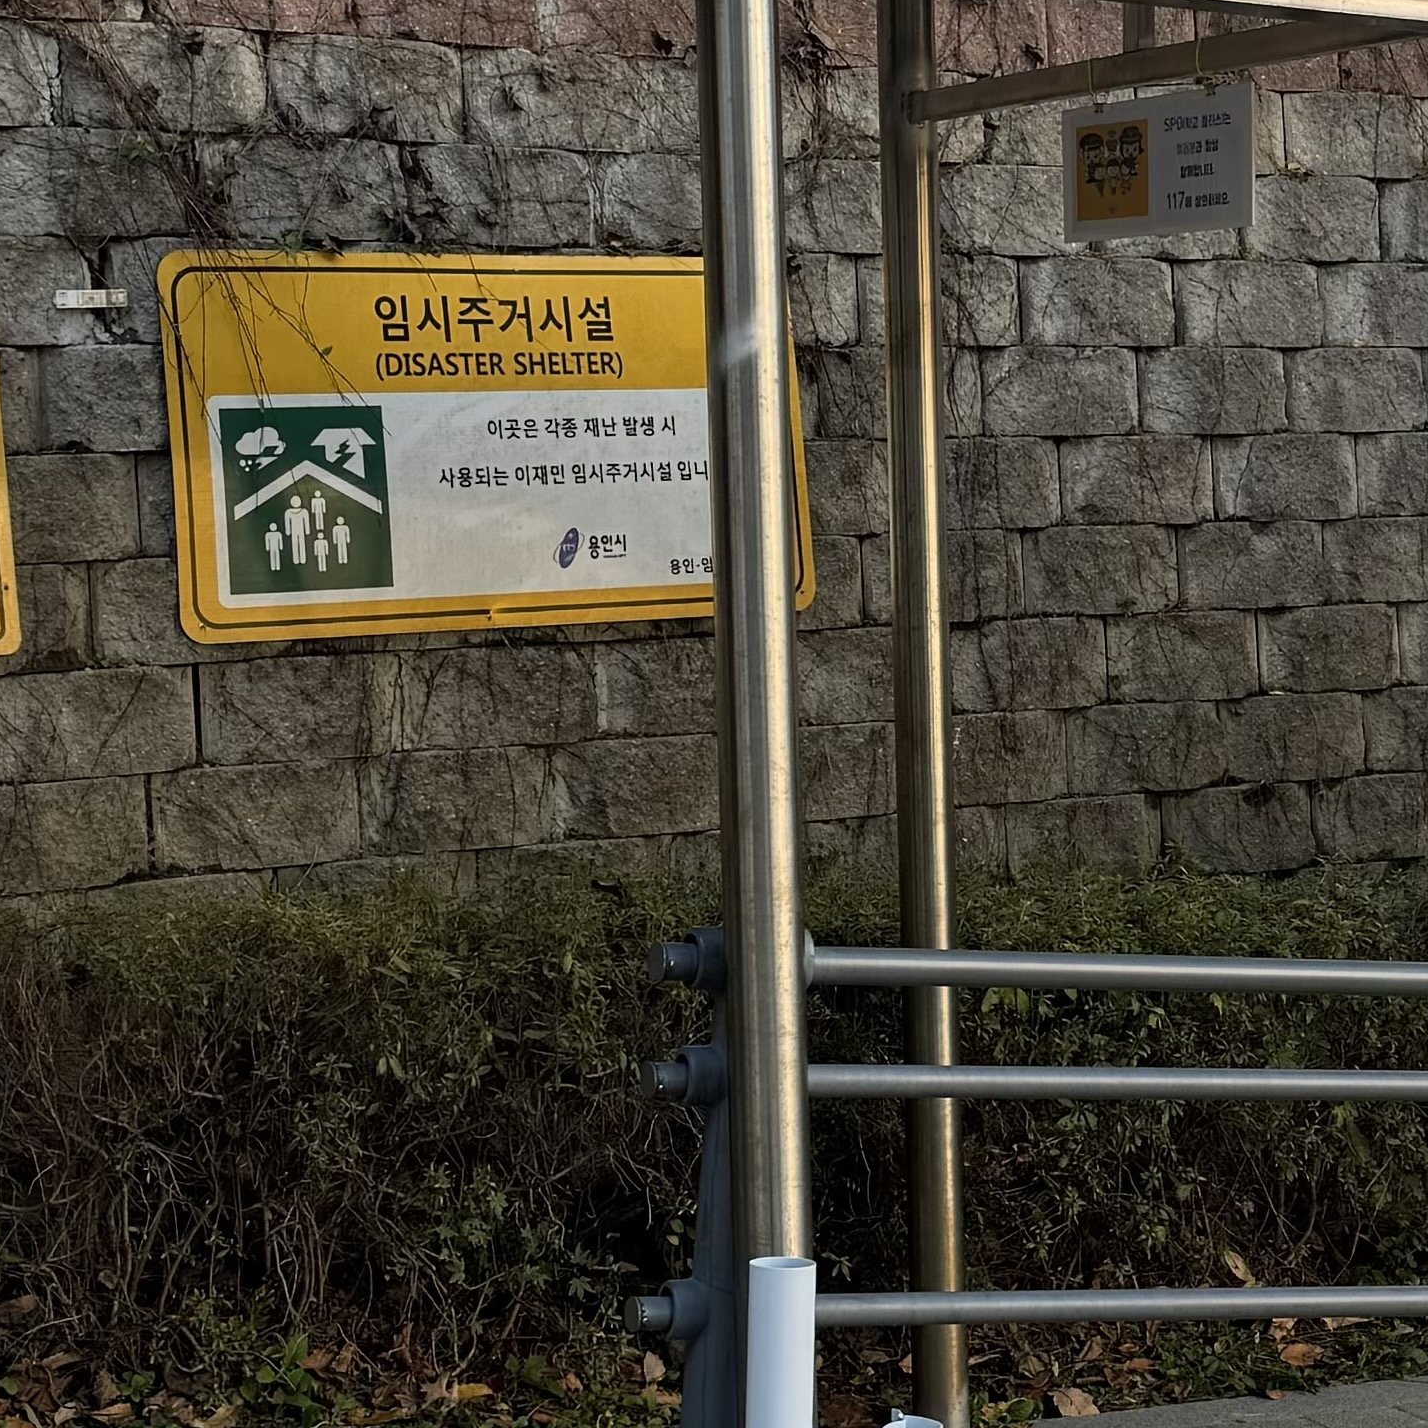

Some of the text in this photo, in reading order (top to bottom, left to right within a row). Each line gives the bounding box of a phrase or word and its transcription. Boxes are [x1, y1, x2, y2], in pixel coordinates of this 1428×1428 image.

[374, 295, 615, 343] 임시주거시설
[375, 351, 624, 382] (DISASTER SHELTER)
[487, 415, 677, 440] 이곳은 각종 재난 발생 시
[438, 460, 709, 489] 사용되는 이재민 임시주거시설 입니
[588, 534, 628, 560] 용인시
[670, 556, 714, 576] 용인-임
